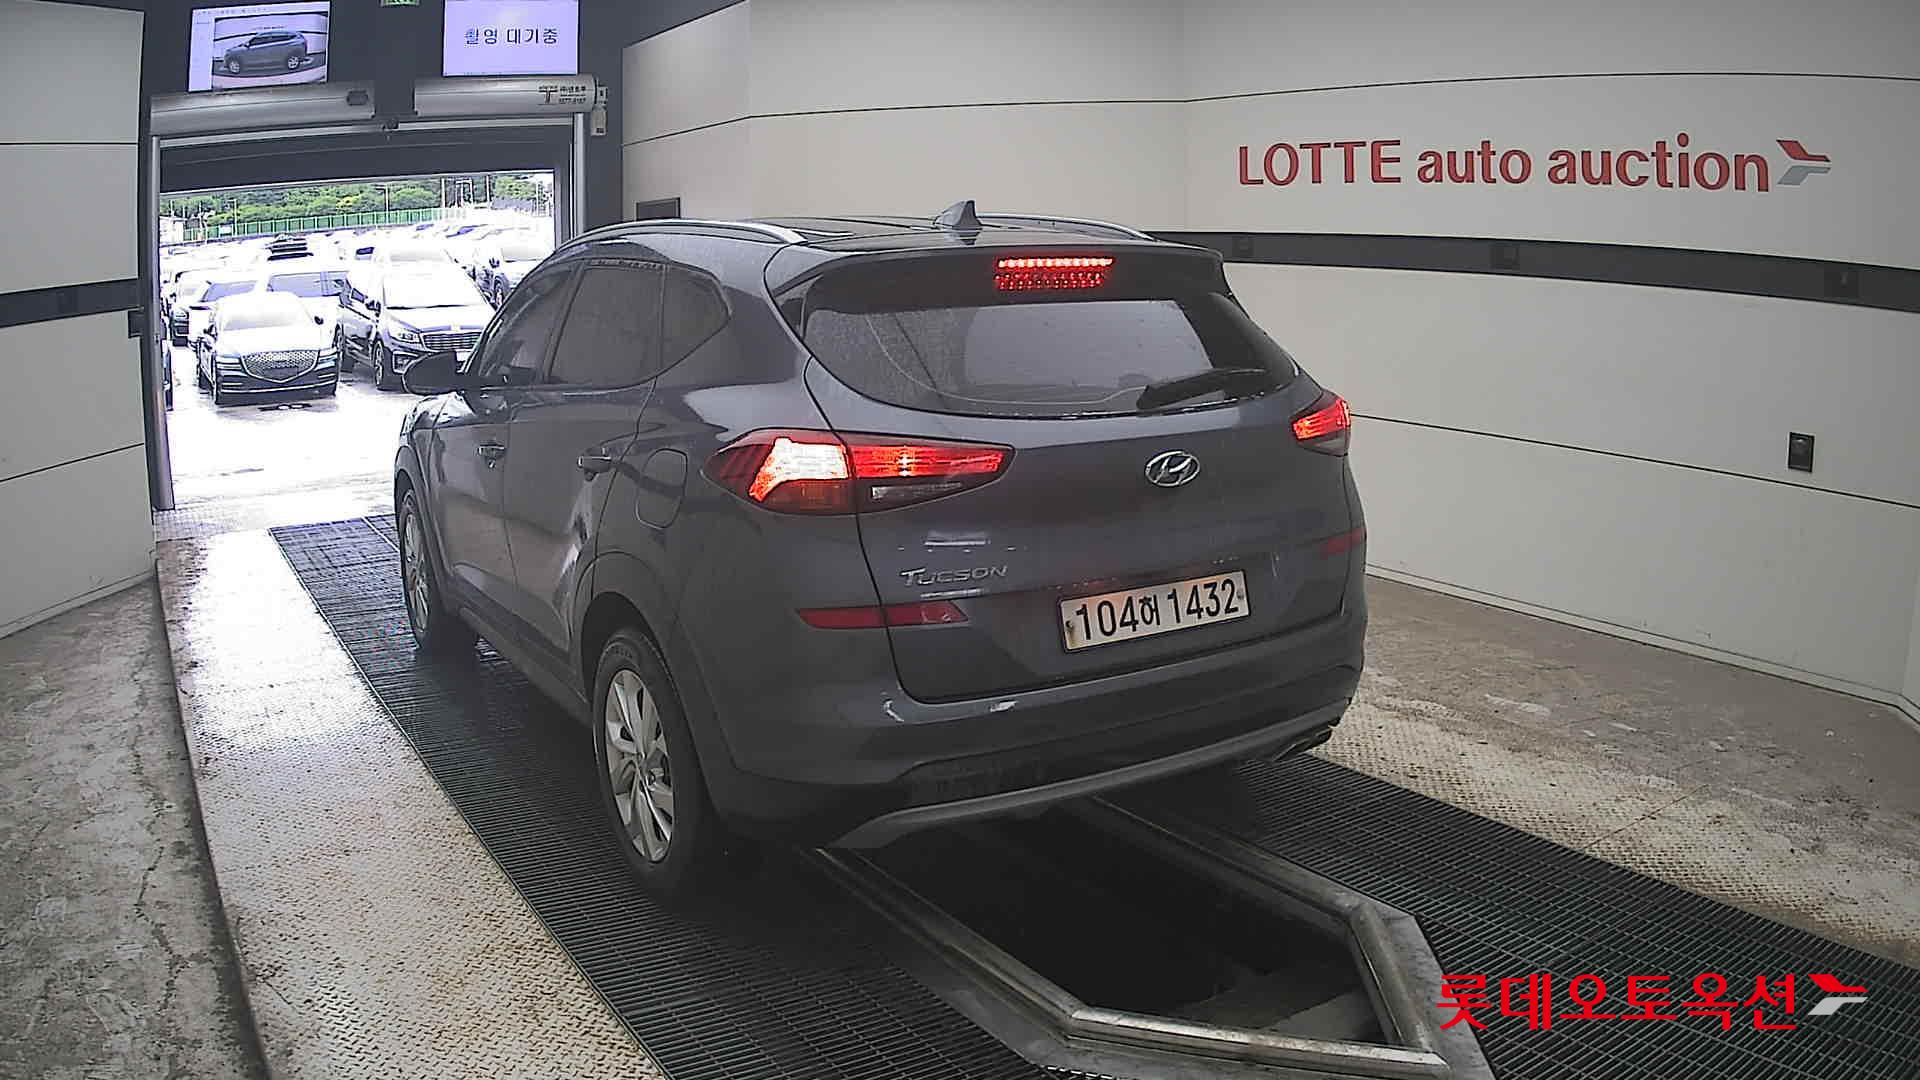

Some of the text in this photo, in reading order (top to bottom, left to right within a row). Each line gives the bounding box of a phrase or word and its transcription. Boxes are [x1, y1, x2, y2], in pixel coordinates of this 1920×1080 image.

[506, 28, 558, 45] 대기중
[1238, 132, 1770, 193] LOTTE auto auction
[900, 566, 1007, 588] TUCSON
[1167, 578, 1239, 624] 1432
